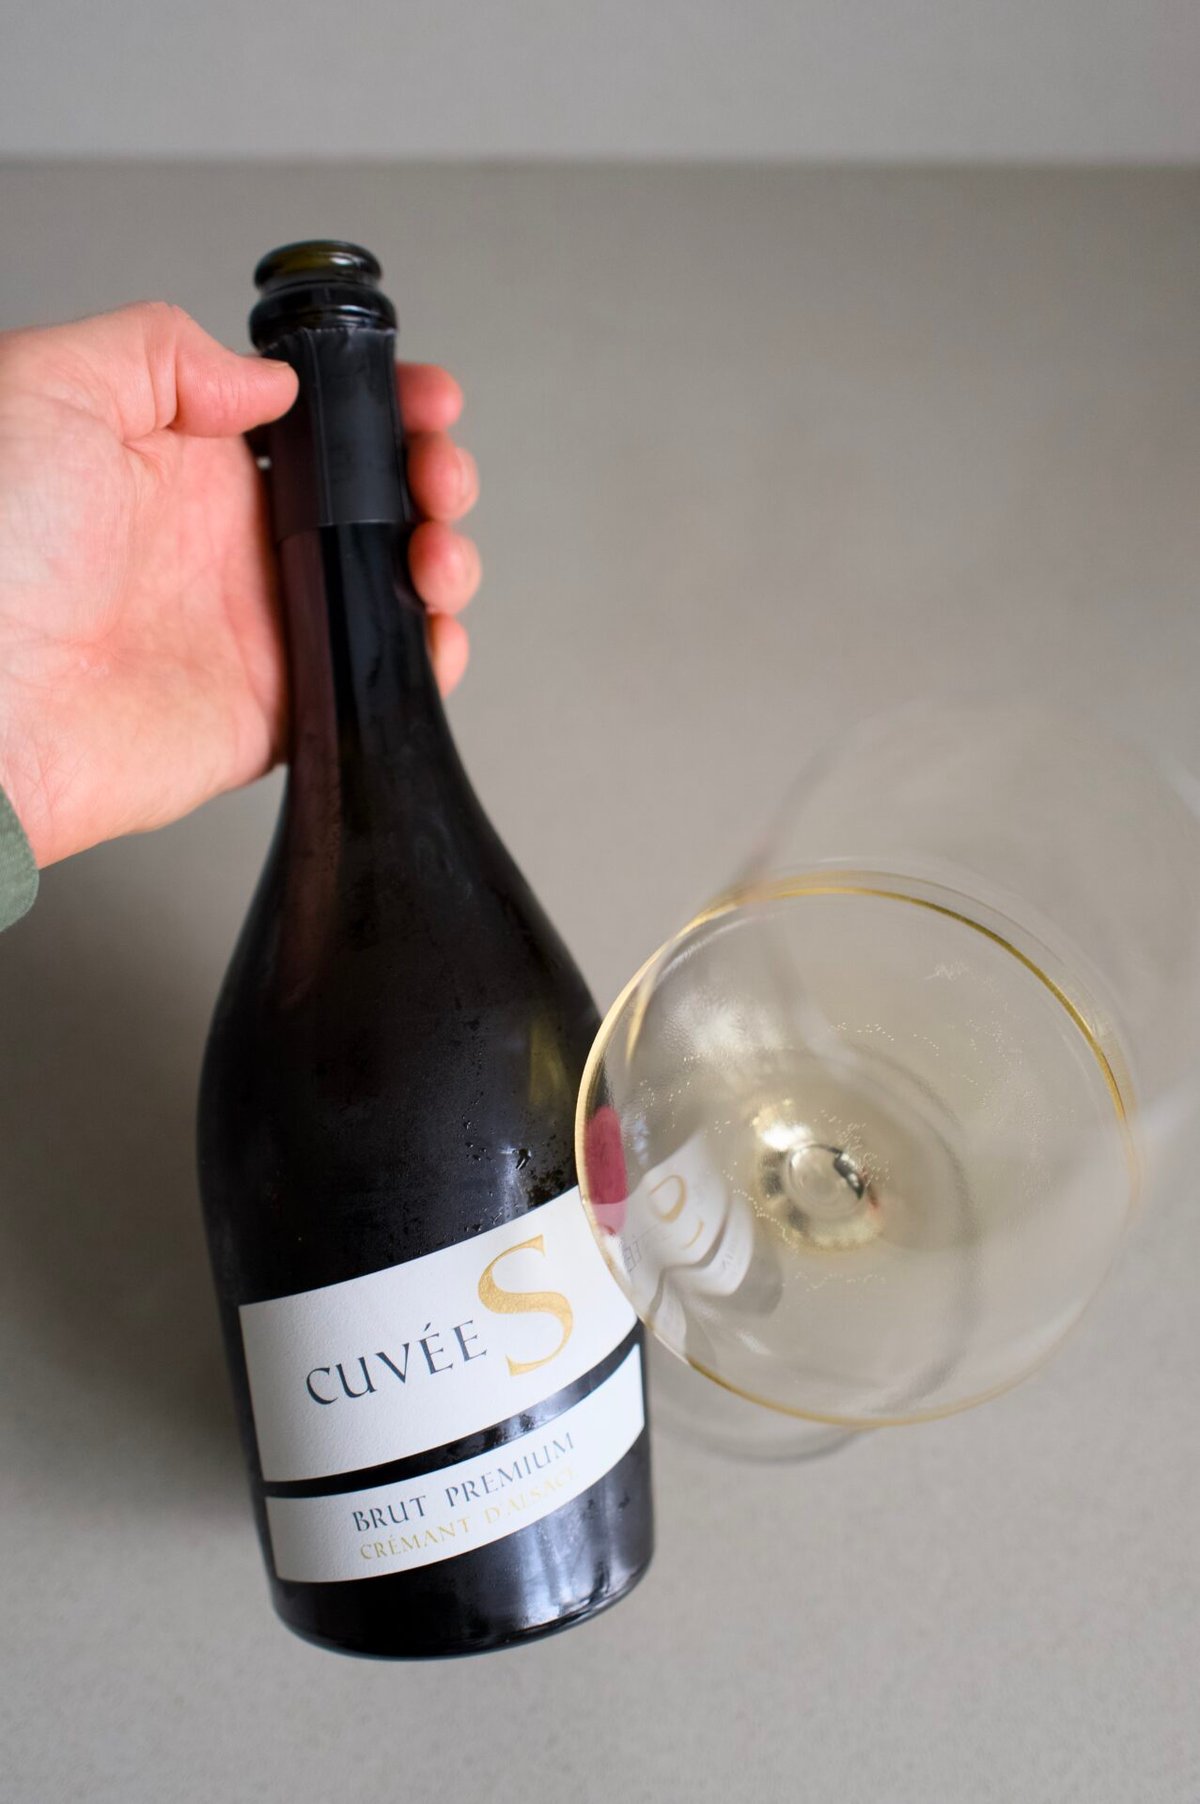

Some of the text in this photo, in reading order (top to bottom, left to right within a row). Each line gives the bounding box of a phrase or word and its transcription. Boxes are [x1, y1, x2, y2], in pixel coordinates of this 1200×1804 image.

[305, 1234, 574, 1405] CUVÉE S
[351, 1432, 575, 1533] BRUT PREMIUM
[359, 1518, 470, 1561] CRÉMANT
